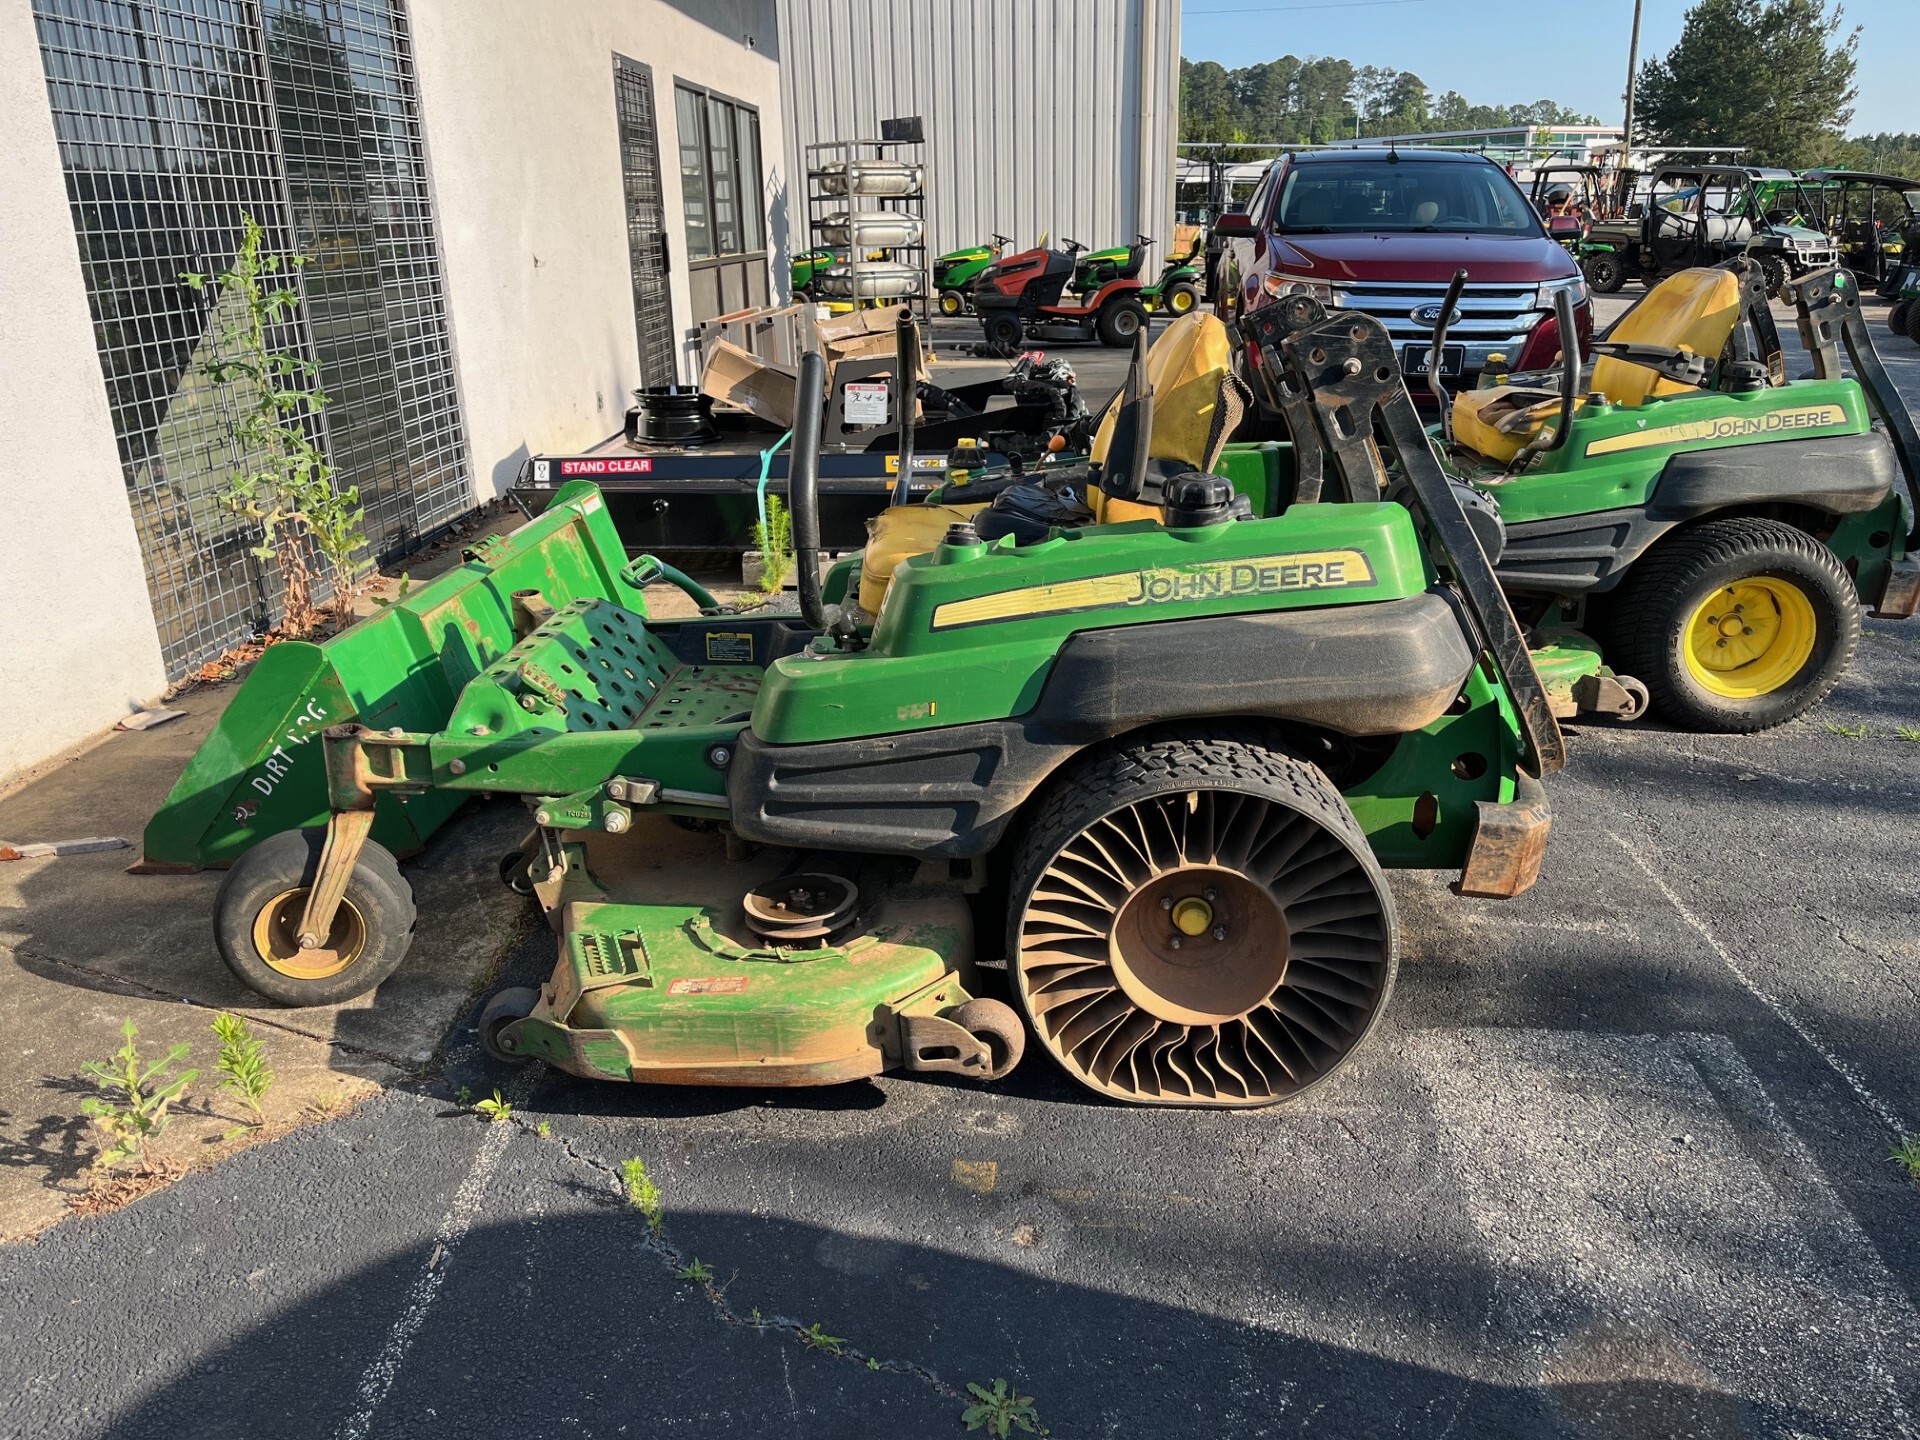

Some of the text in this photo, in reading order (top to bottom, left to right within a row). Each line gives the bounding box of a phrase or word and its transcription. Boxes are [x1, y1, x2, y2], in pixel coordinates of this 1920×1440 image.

[1705, 411, 1831, 439] JOHN DEERE
[564, 460, 649, 473] STAND CLEAR
[1127, 561, 1347, 604] JOHN DEERE
[1209, 779, 1241, 788] TURF
